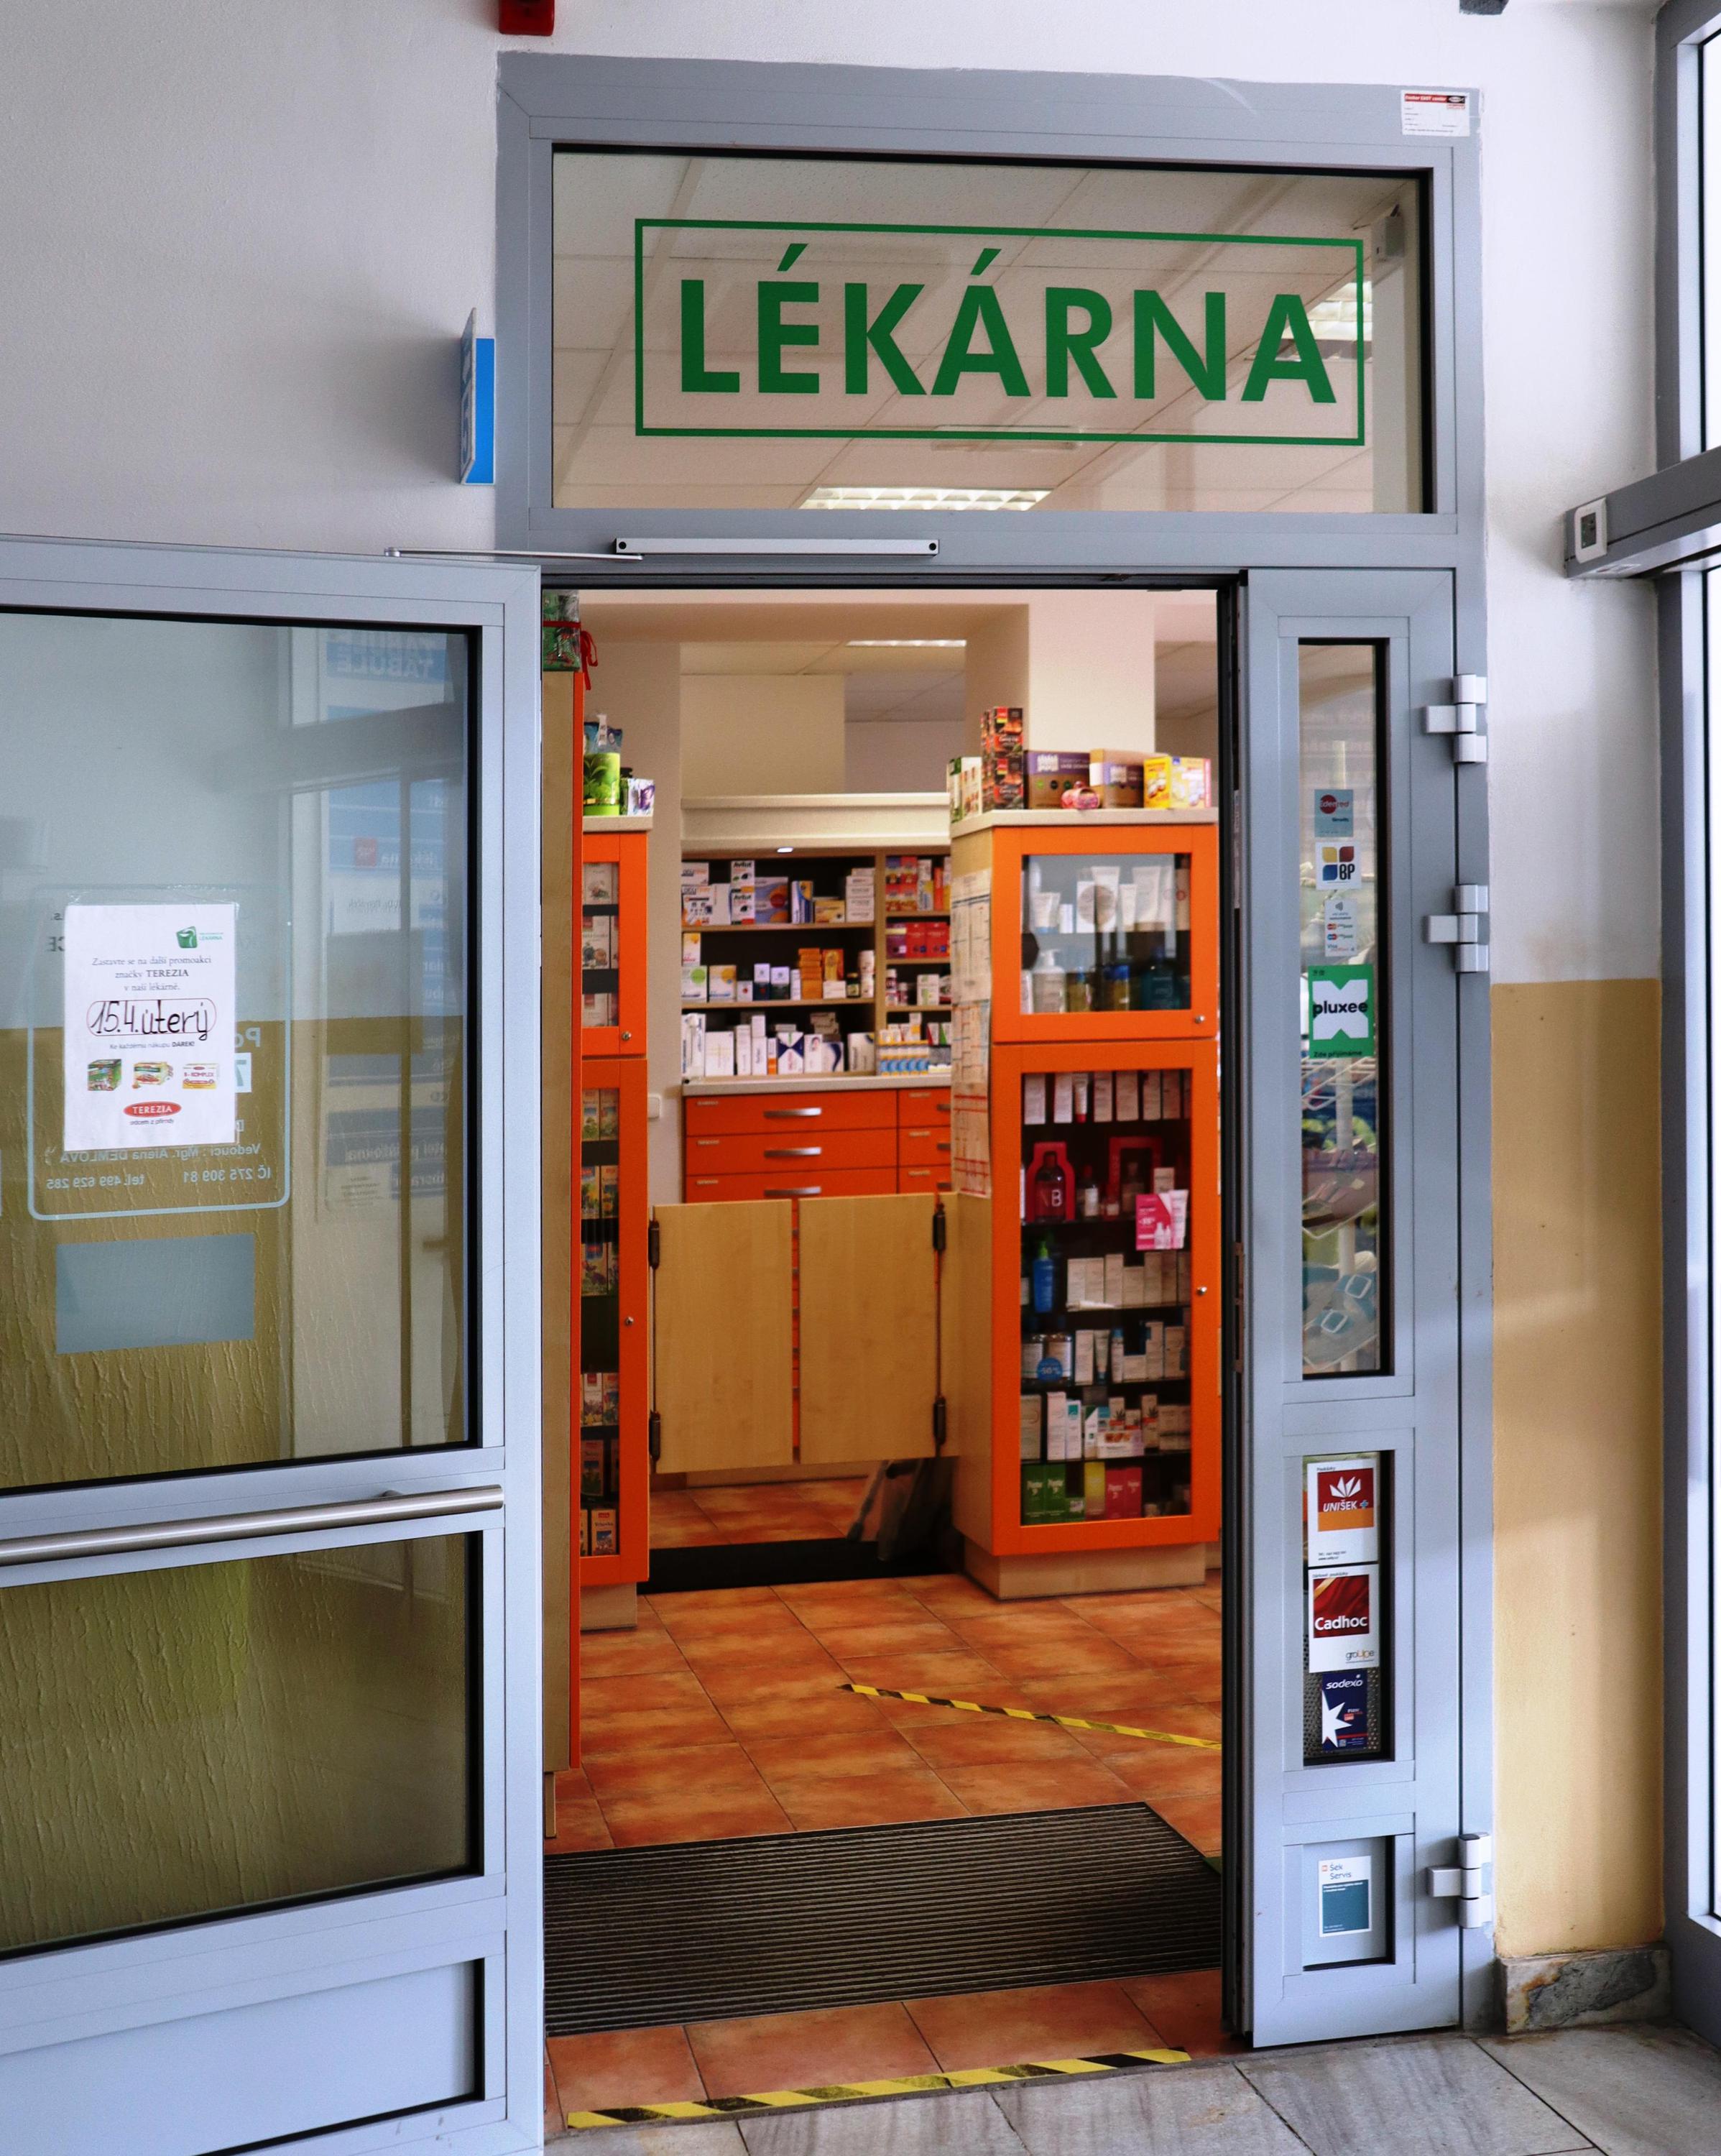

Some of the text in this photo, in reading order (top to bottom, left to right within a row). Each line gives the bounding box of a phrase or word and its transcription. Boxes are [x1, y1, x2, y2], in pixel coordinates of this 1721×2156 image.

[680, 243, 1337, 404] LÉKÁRNA
[1339, 864, 1355, 880] BP
[146, 969, 189, 977] TEREZIA
[1312, 1000, 1368, 1018] pluxee
[132, 1105, 173, 1115] TEREZIA
[1323, 1499, 1357, 1513] UNIŠEK
[1314, 1615, 1368, 1631] Cadhoc
[1325, 1679, 1364, 1690] sodexo
[1329, 1871, 1352, 1880] Servis
